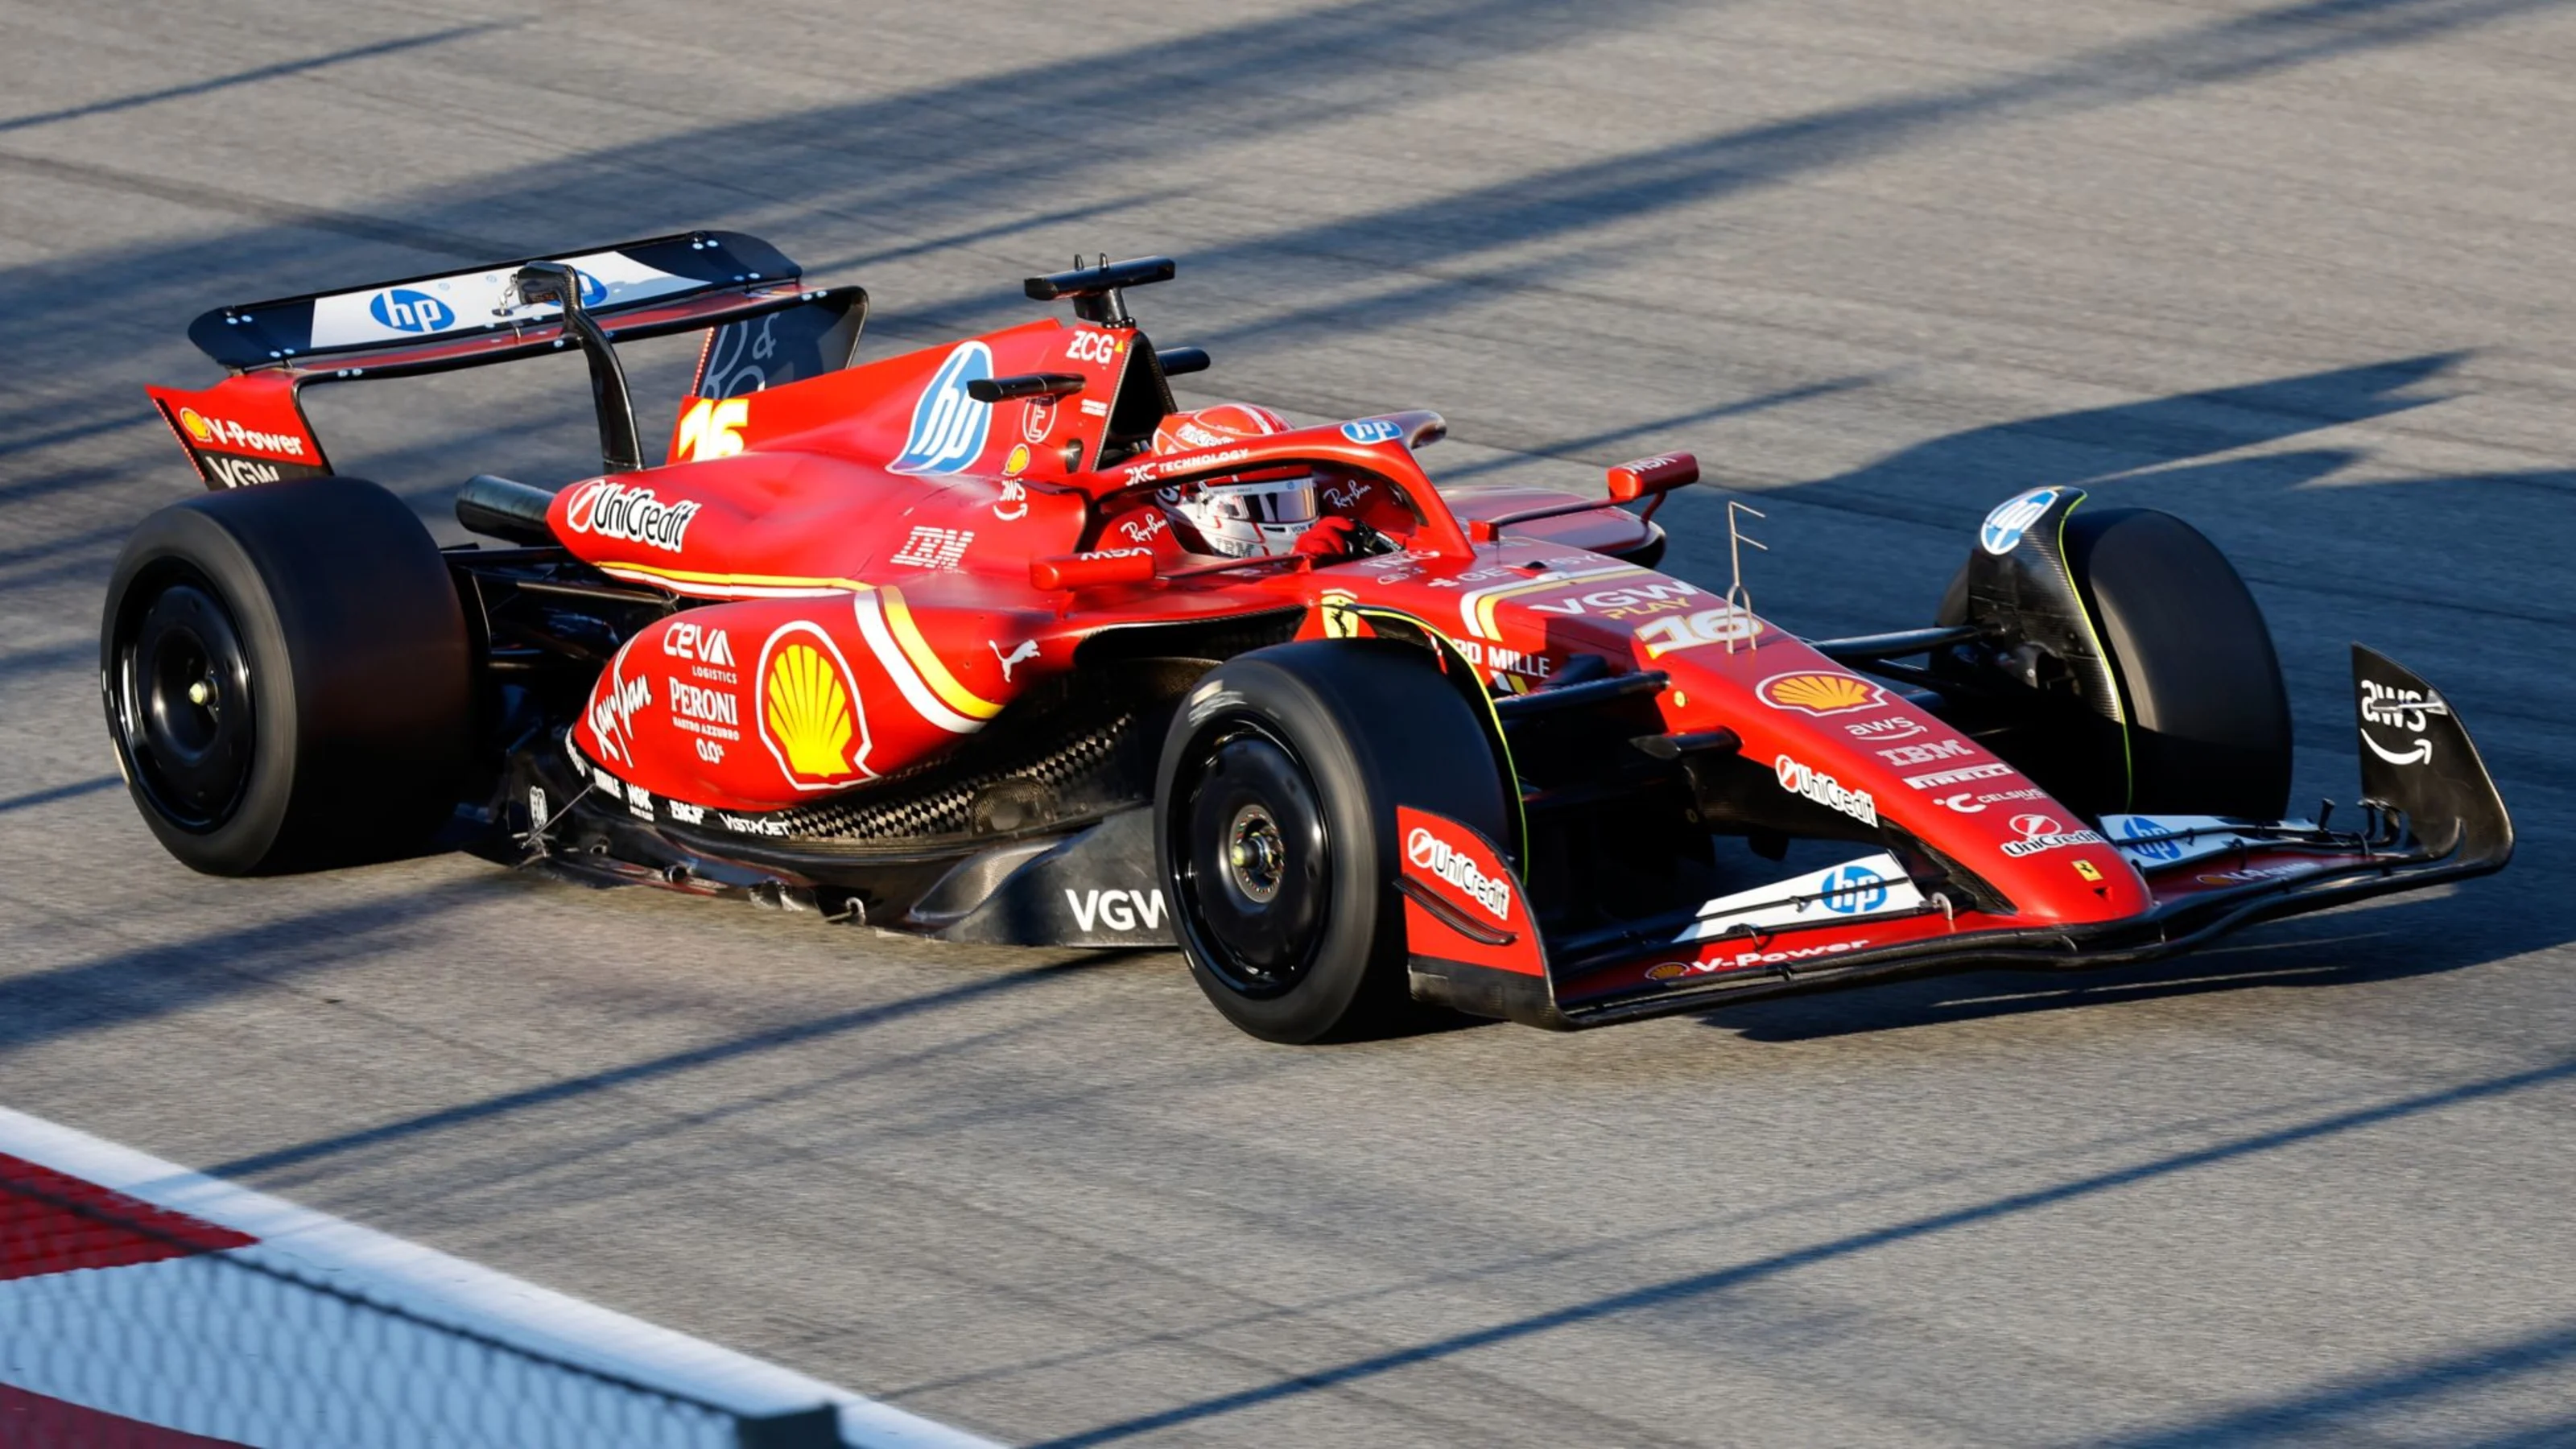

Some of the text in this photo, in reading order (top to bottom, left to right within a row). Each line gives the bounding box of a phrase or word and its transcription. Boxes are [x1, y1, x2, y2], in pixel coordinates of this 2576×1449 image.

[380, 289, 445, 332] hp
[1066, 330, 1115, 364] ZCG
[204, 416, 303, 456] V-Power
[678, 398, 749, 463] 16
[1354, 421, 1395, 443] hp
[1158, 448, 1249, 473] TECHNOLOGY
[592, 485, 696, 547] UniCredit
[890, 526, 974, 568] IBM
[1529, 580, 1699, 615] VGW
[1600, 597, 1691, 621] PLAY
[1634, 607, 1764, 659] 16
[692, 666, 738, 684] LOGISTICS
[1488, 646, 1550, 678] MILLE
[669, 676, 739, 726] PERONI
[701, 723, 740, 742] AZZURRO
[1844, 716, 1915, 736] aws
[1876, 739, 1975, 766] IBM
[1902, 763, 2014, 790] PIRELLI
[1798, 765, 1876, 824] UniCredit
[1977, 788, 2046, 803] CELSIUS
[2003, 830, 2104, 857] UniCredit
[1435, 842, 1509, 919] UniCredit
[1829, 867, 1882, 912] hp
[1064, 889, 1169, 931] VGW
[1692, 938, 1869, 972] V-Power
